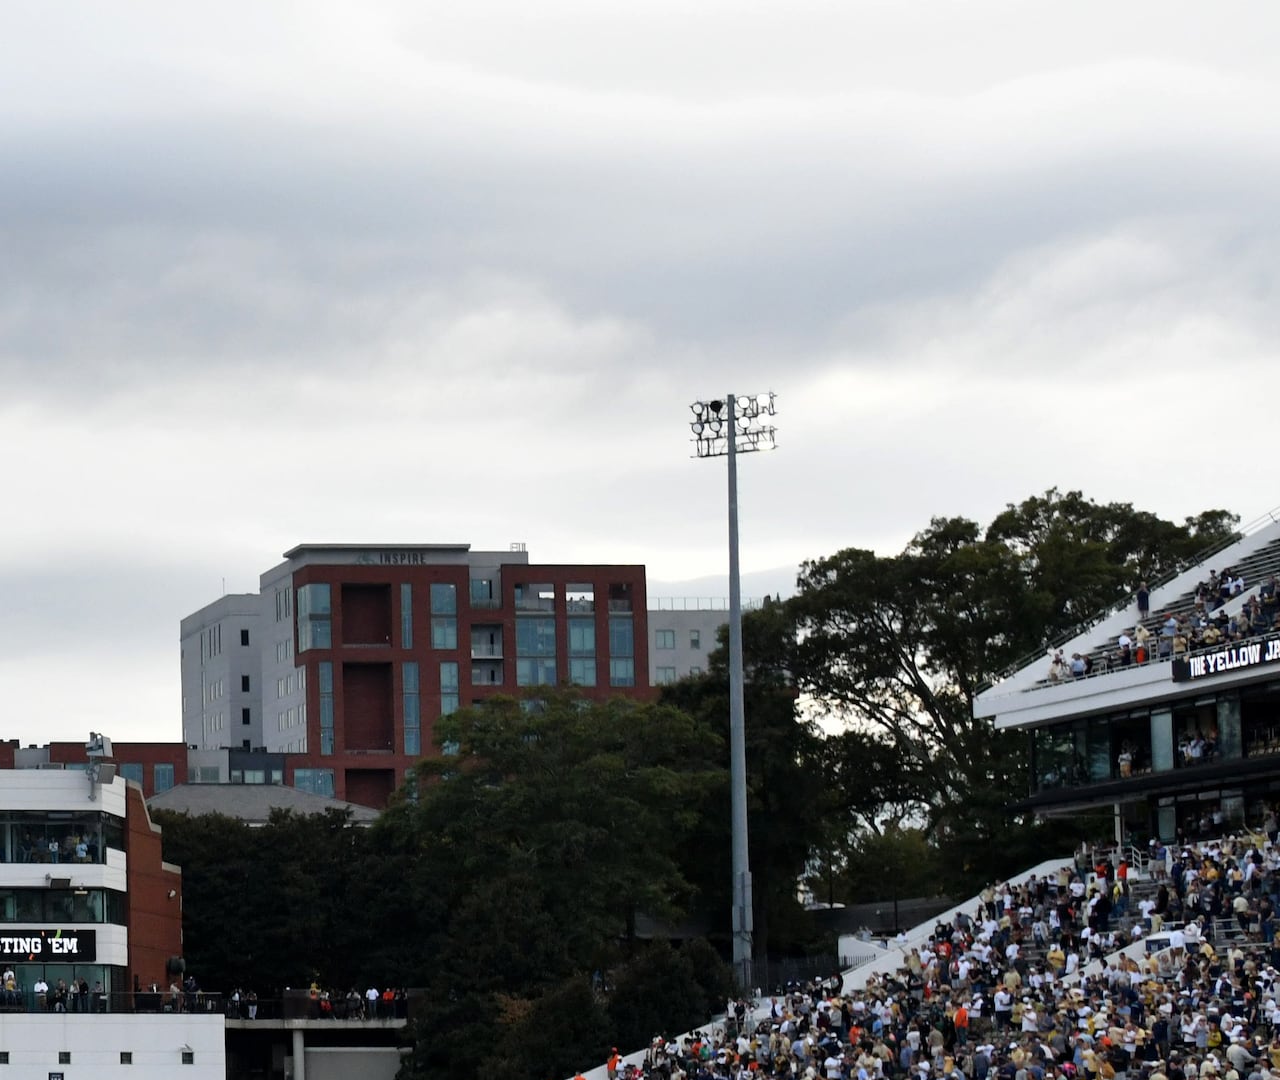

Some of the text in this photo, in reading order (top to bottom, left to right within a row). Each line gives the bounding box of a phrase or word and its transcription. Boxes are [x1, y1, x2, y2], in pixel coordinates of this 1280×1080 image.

[379, 551, 427, 564] INSPIRE
[1190, 655, 1206, 678] THE
[1206, 643, 1261, 675] YELLOW
